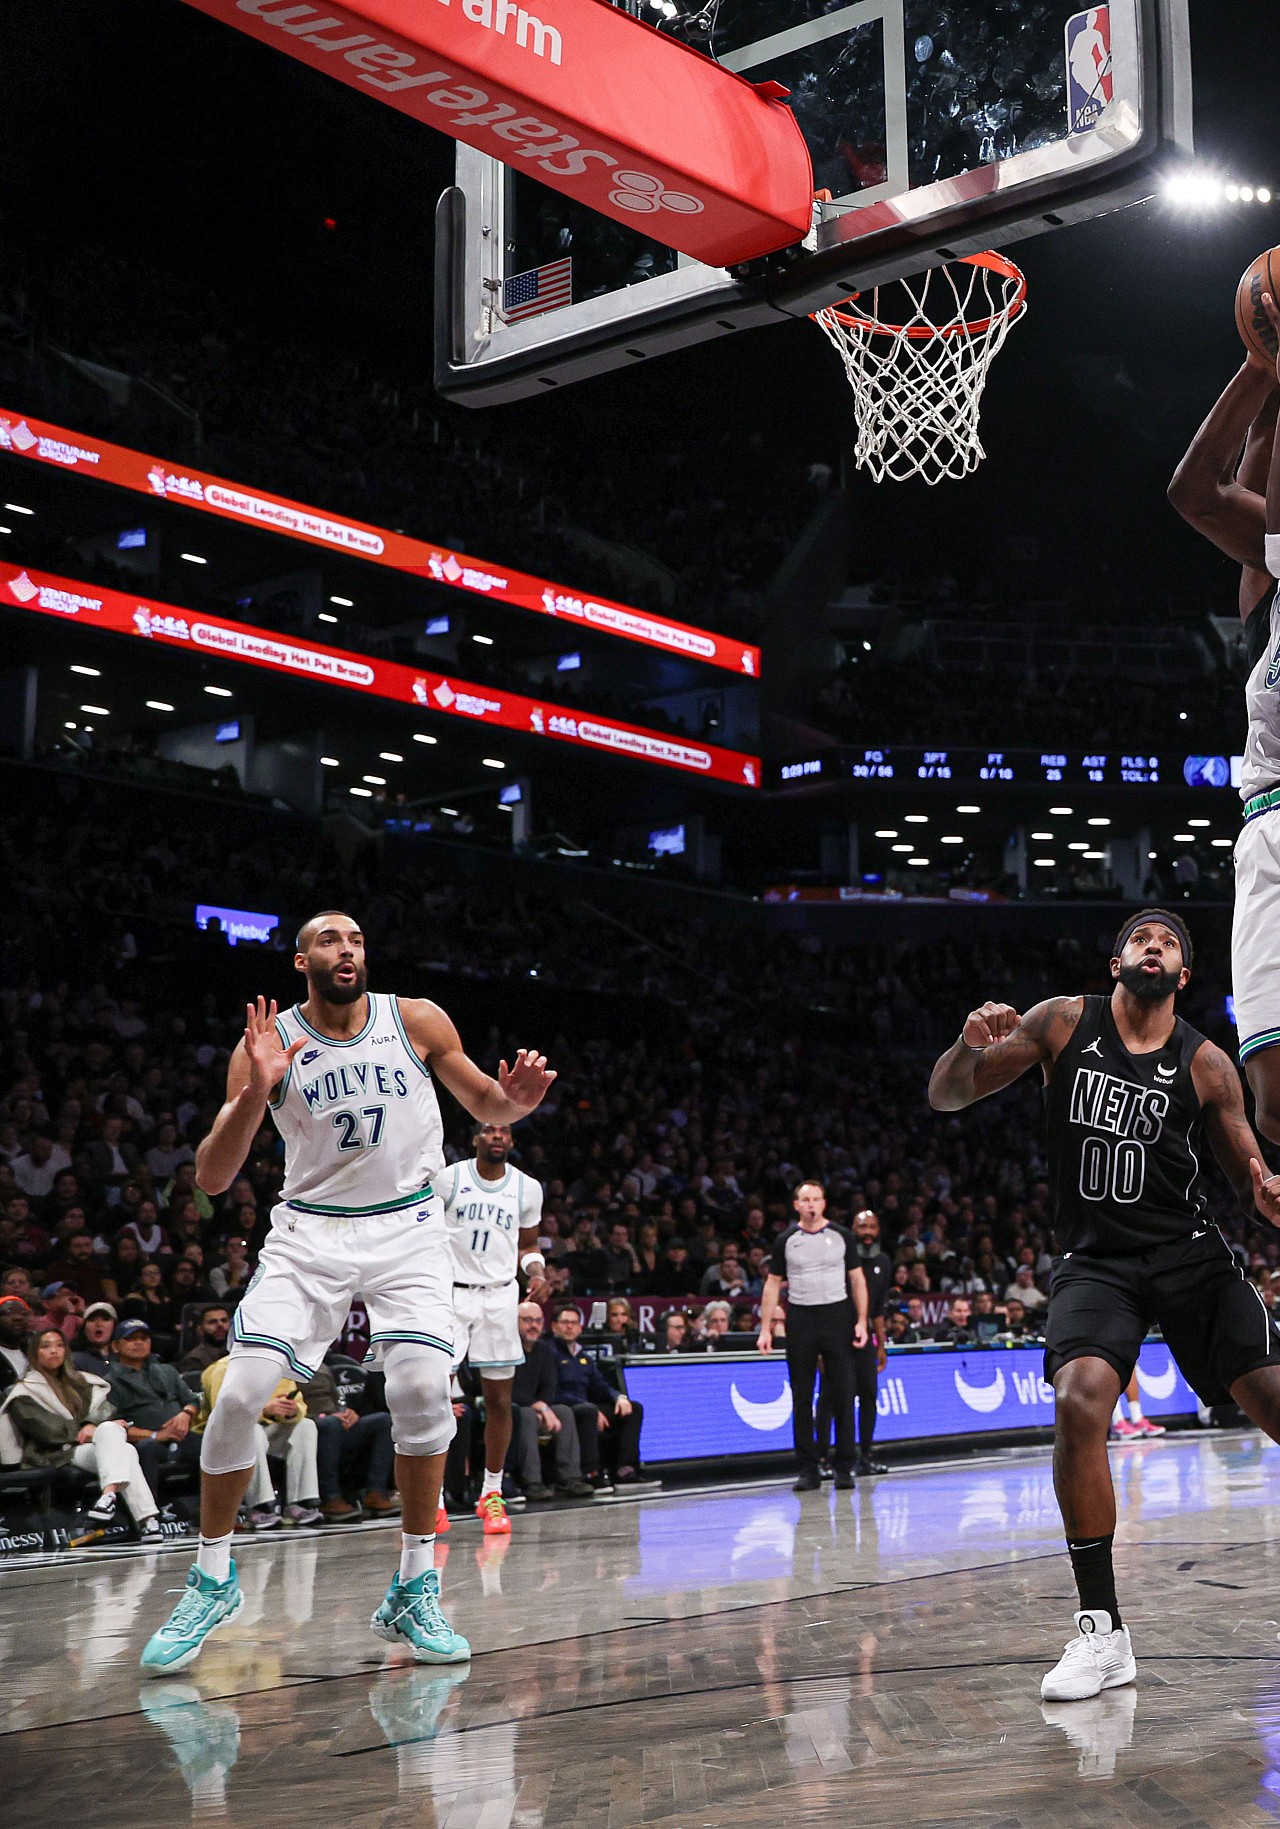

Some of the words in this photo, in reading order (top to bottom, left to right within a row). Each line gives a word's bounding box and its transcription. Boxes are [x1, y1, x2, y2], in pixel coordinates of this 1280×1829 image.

[436, 0, 562, 66] arm
[211, 490, 250, 514] Global
[254, 503, 299, 529] Leading
[303, 518, 322, 532] Hot
[325, 525, 344, 539] Pot
[347, 532, 379, 551] Brand
[197, 628, 238, 648] Global
[241, 639, 287, 662] Leading
[290, 652, 310, 666] Hot
[314, 658, 332, 672] Pot
[336, 664, 369, 680] Brand
[301, 1061, 409, 1115] WOLVES
[1070, 1067, 1169, 1145] NETS
[1153, 1075, 1174, 1085] Webull
[332, 1104, 388, 1152] 27
[1079, 1137, 1145, 1203] 00
[456, 1203, 513, 1230] WOLVES
[471, 1229, 490, 1252] 11
[876, 1378, 908, 1417] ull
